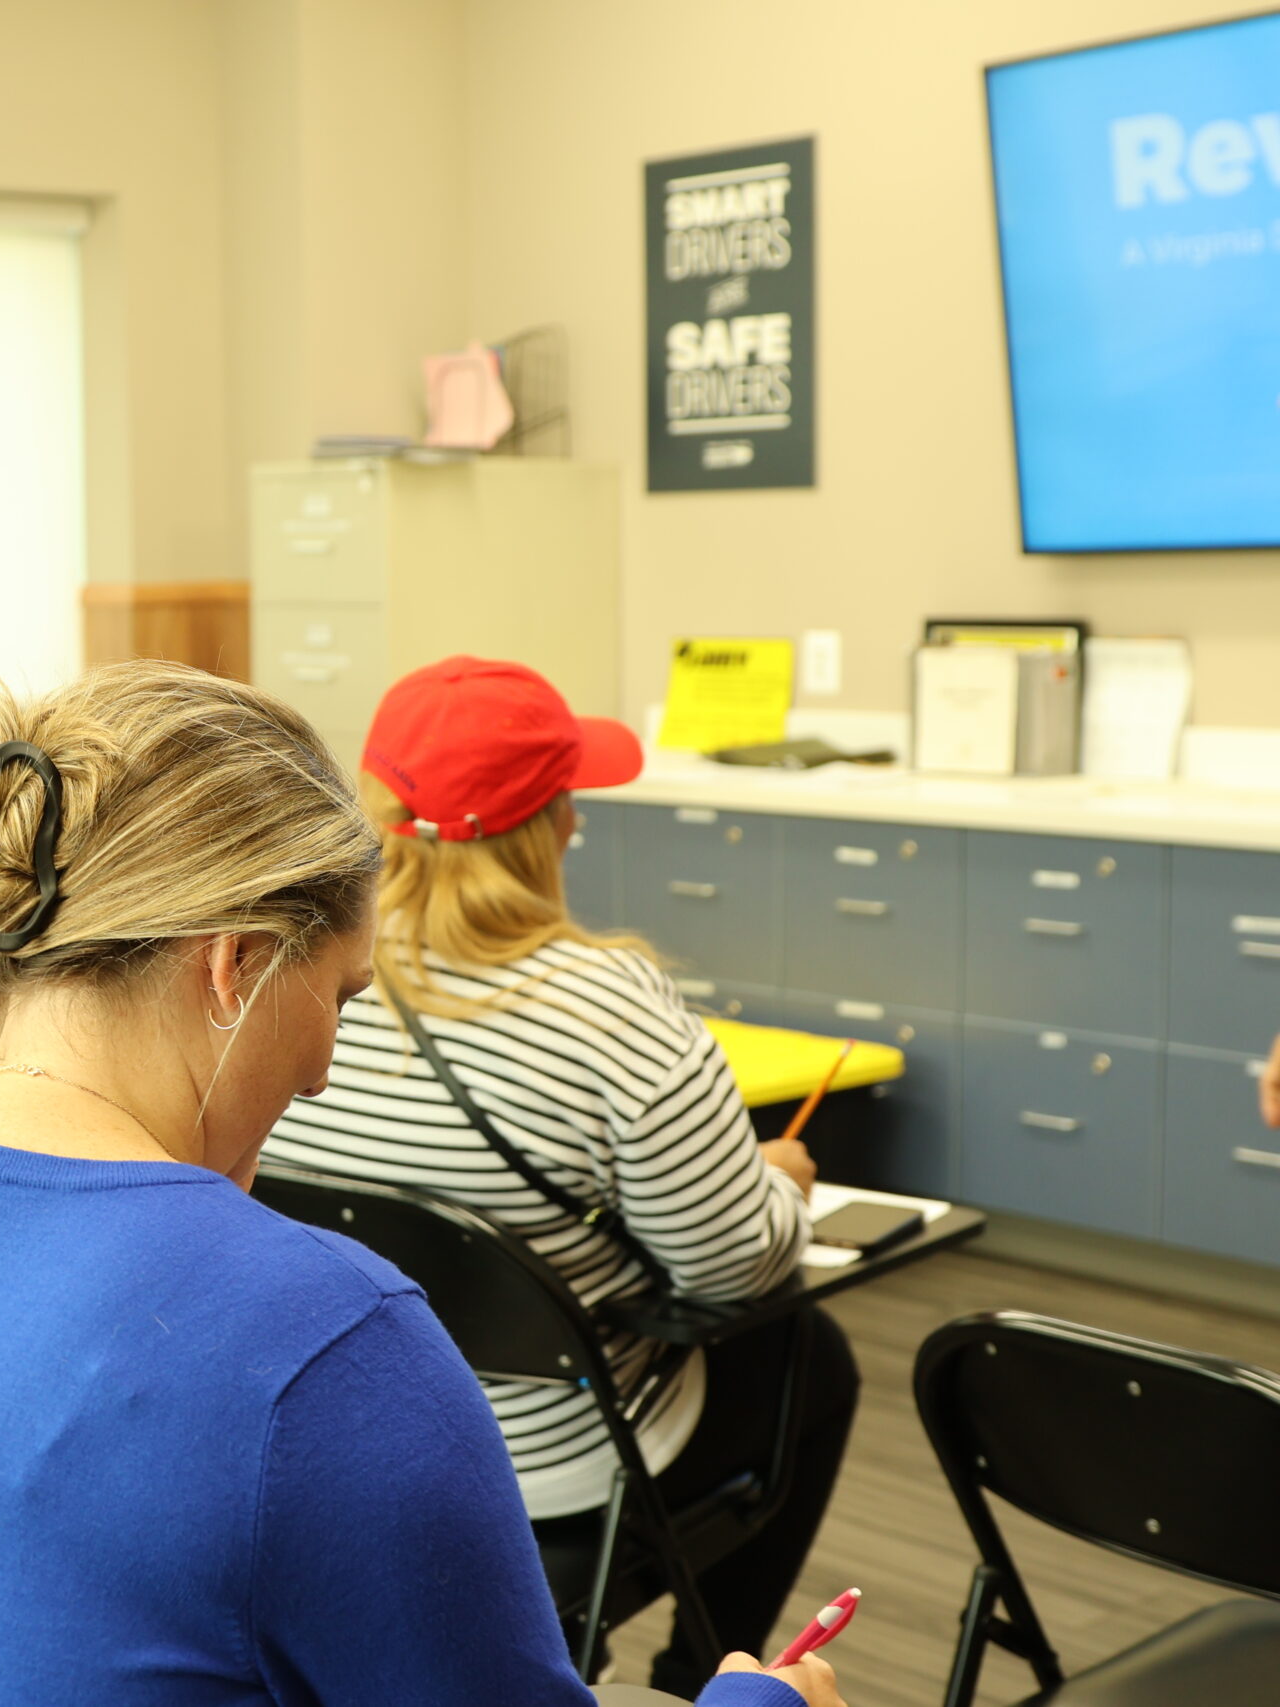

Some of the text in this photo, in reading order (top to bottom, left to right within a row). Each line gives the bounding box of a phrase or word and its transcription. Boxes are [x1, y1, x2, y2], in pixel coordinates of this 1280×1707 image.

[666, 178, 789, 229] SMART
[666, 218, 790, 280] DRIVERS
[667, 313, 790, 370] SAFE
[667, 364, 790, 418] DRIVERS
